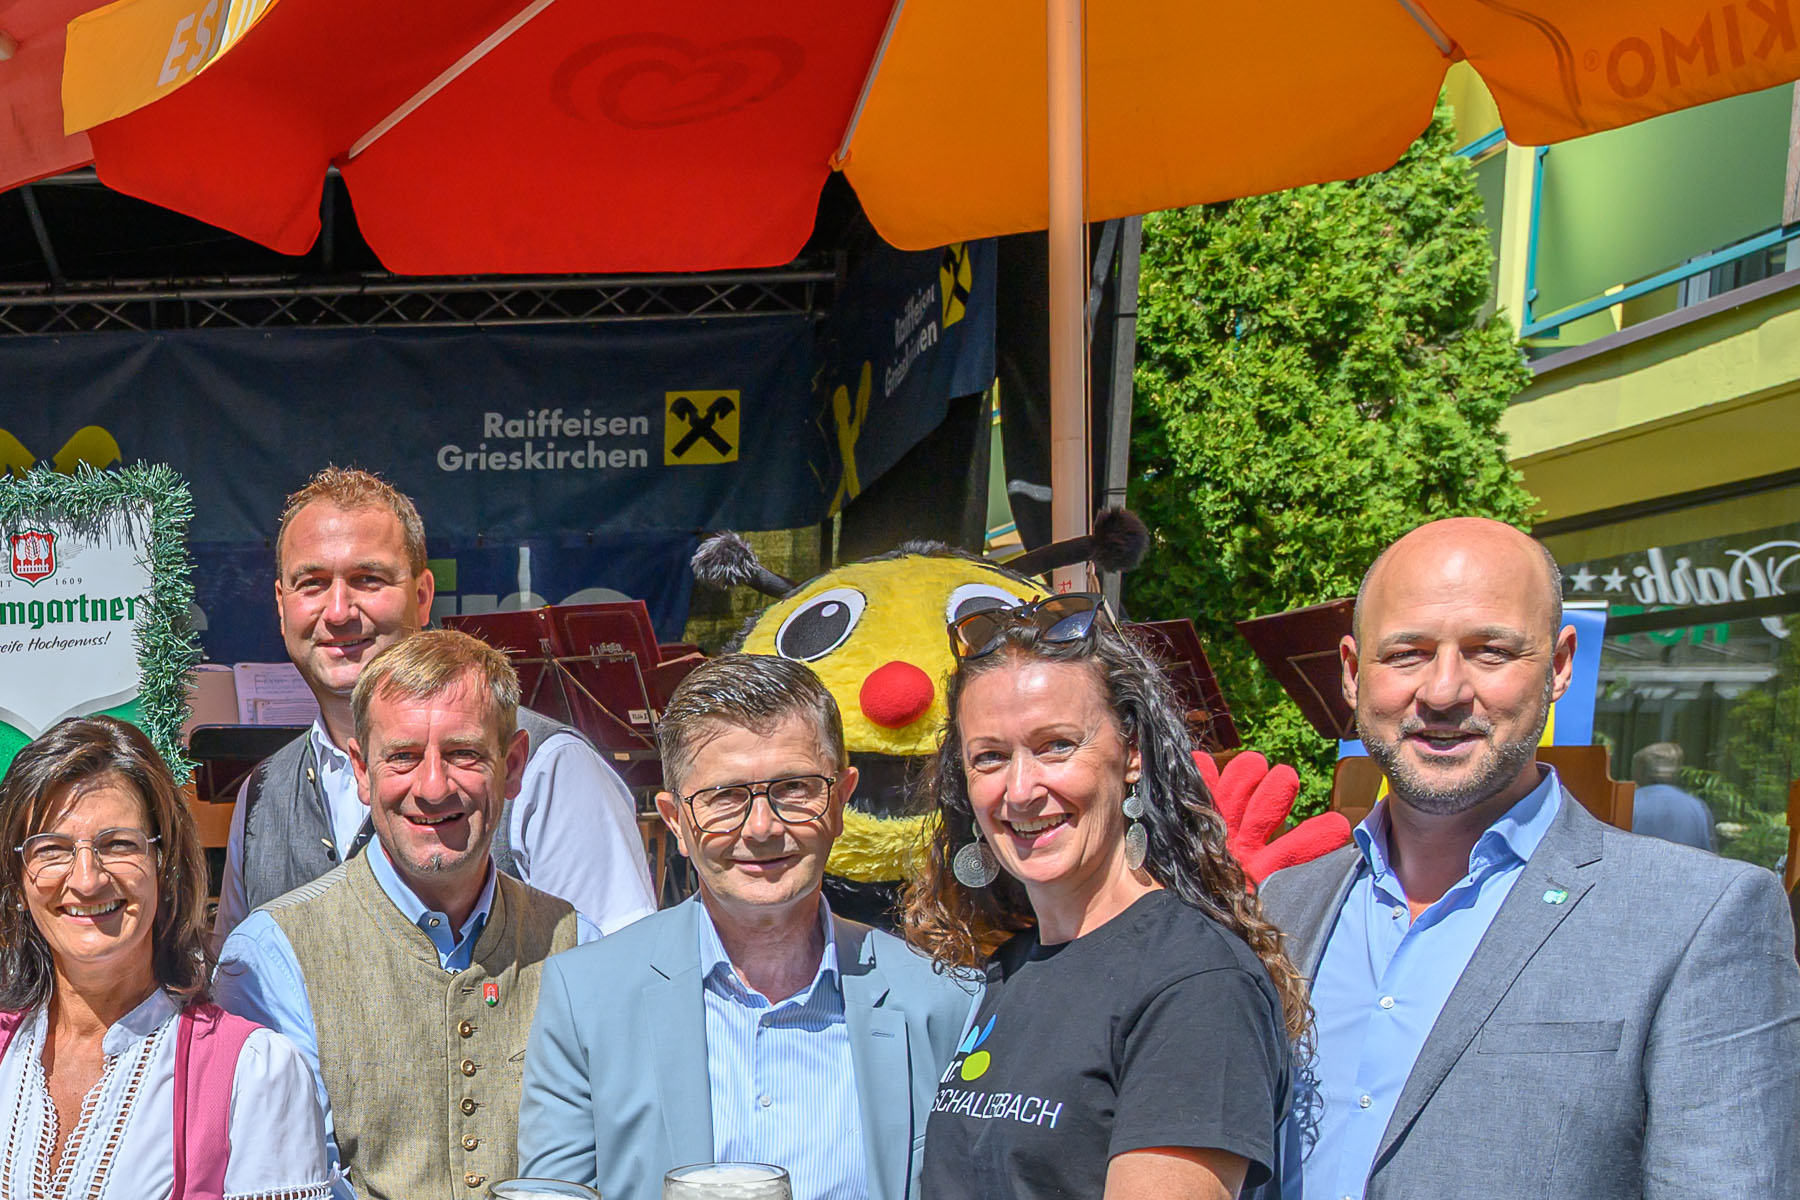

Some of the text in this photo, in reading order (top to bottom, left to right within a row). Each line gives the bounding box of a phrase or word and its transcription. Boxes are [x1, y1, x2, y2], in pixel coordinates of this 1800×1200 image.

[483, 408, 649, 438] Raiffeisen
[436, 440, 649, 472] Grieskirchen
[55, 577, 84, 586] 1609
[28, 631, 112, 652] Hochgenuss!
